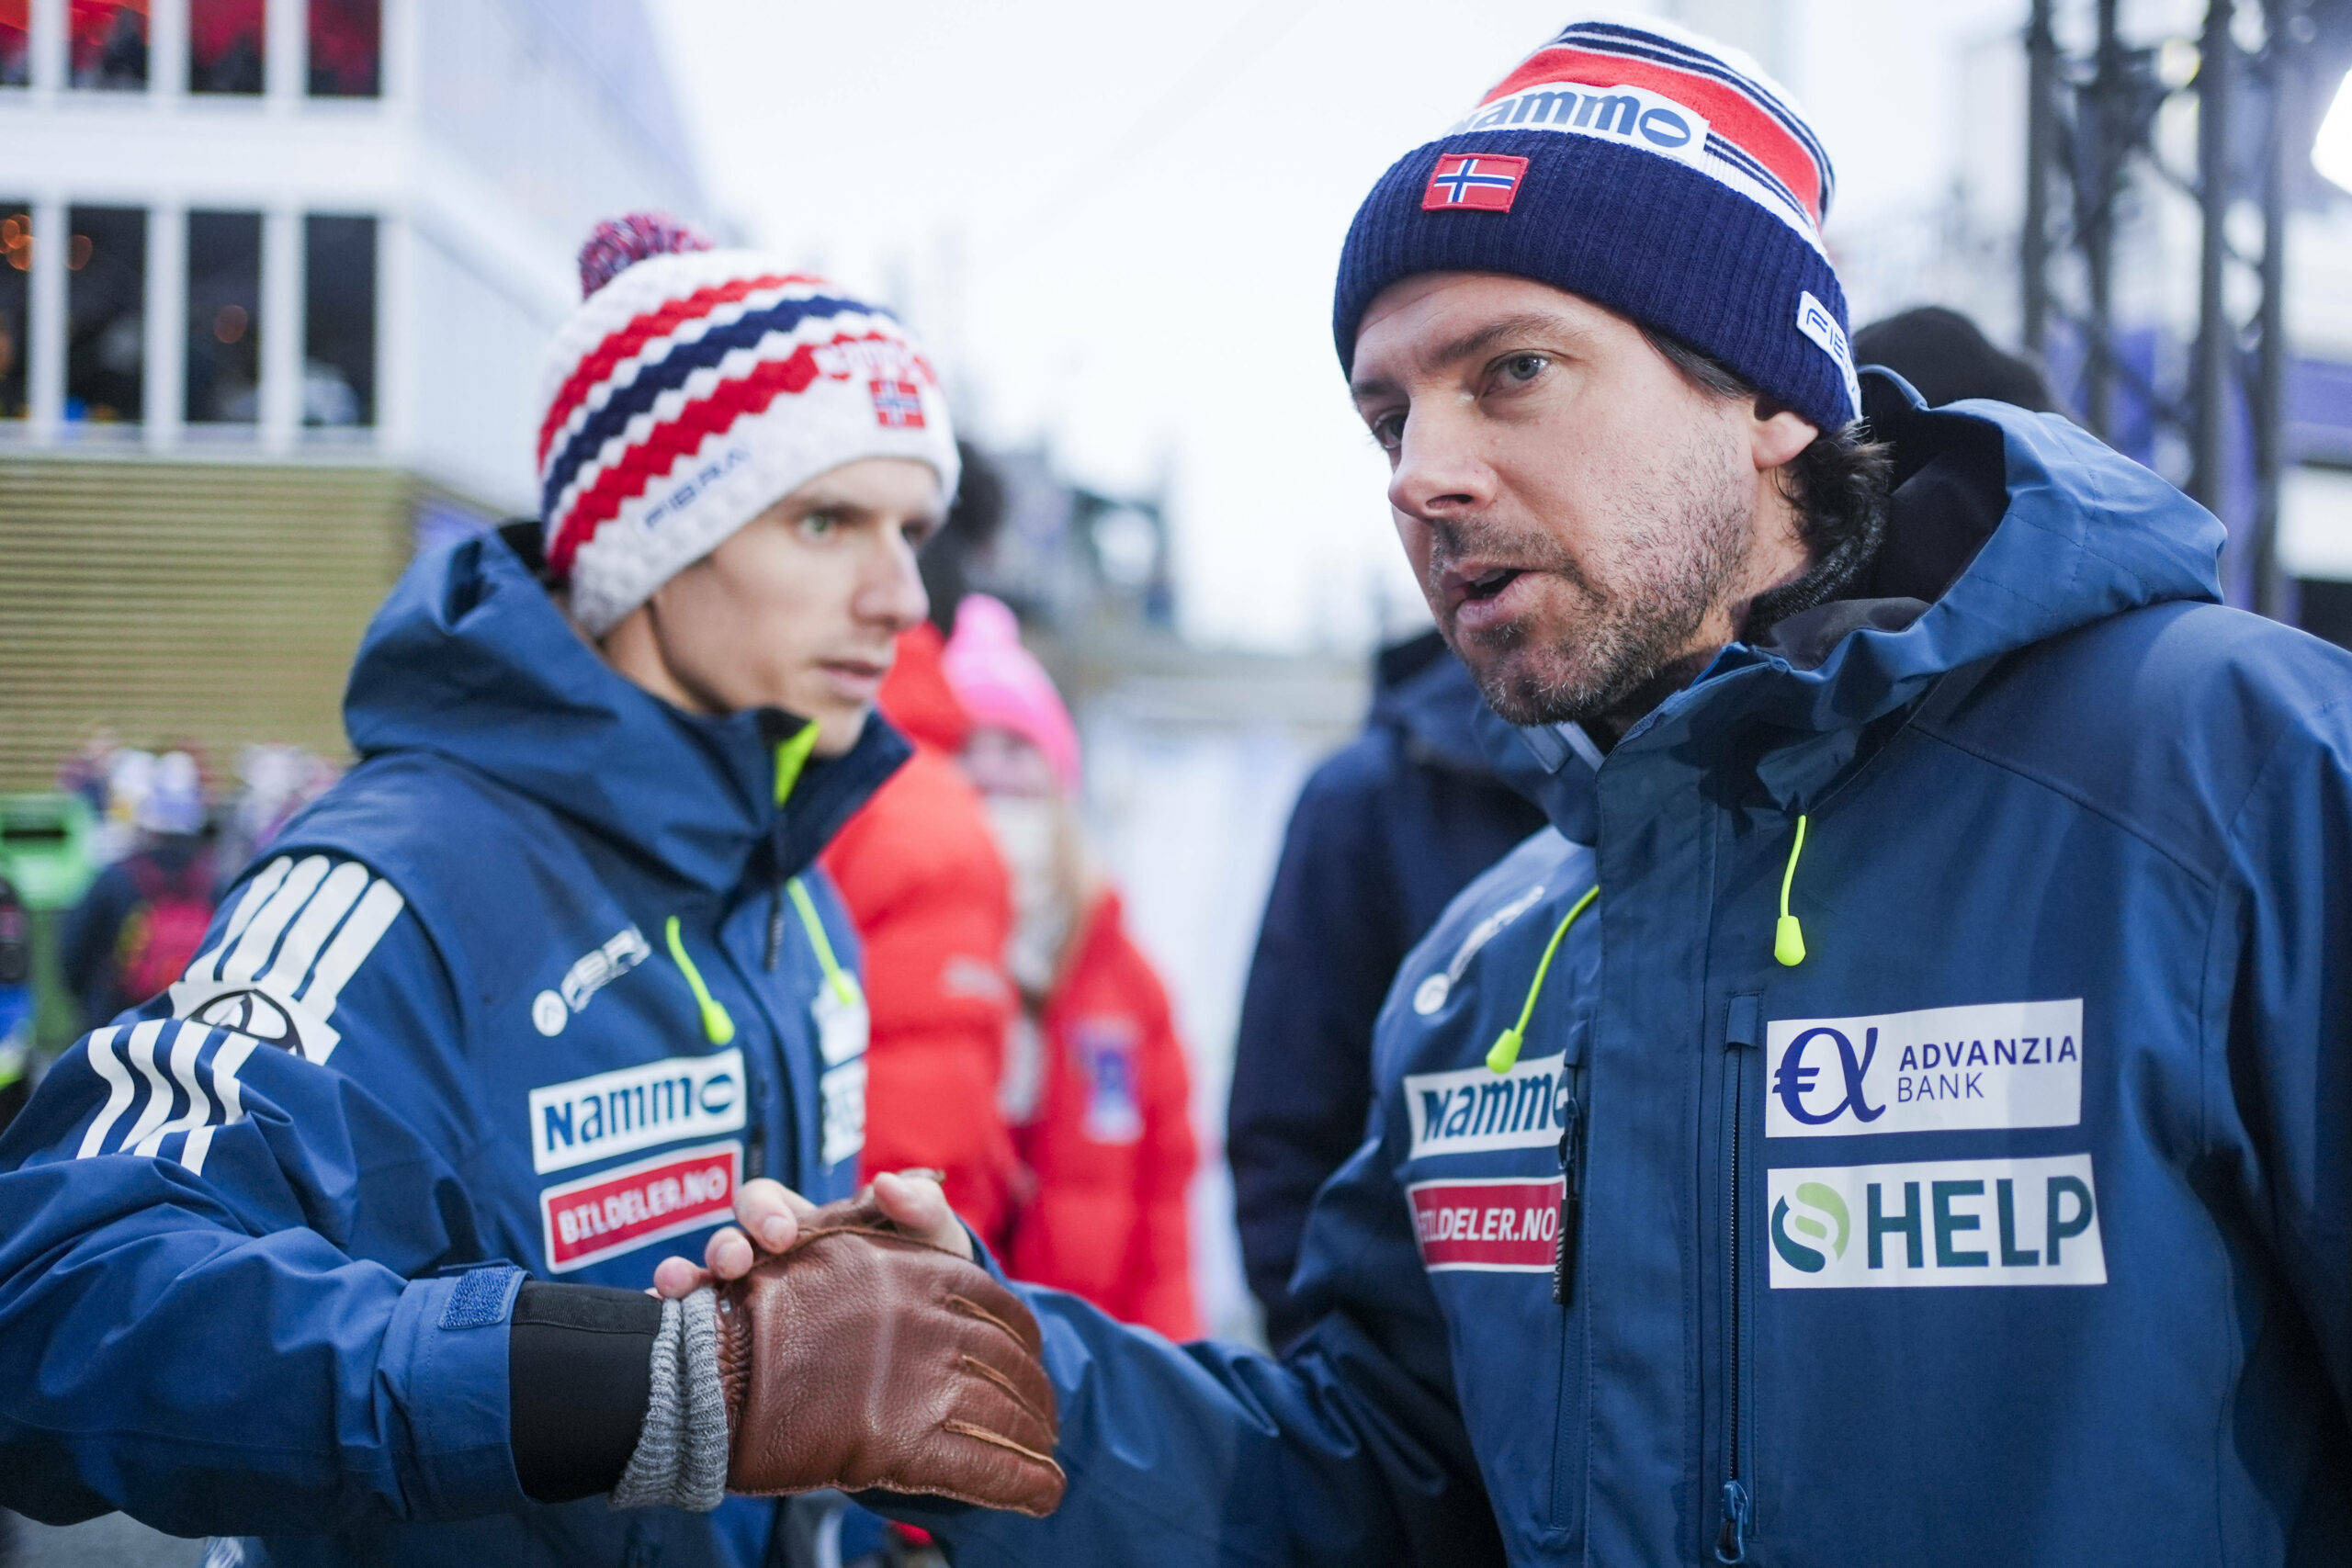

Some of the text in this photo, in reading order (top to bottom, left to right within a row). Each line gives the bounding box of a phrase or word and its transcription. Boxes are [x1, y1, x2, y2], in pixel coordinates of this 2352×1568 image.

[1805, 308, 1856, 393] FIB
[1897, 1072, 1984, 1102] BANK
[1899, 1035, 2077, 1071] ADVANZIA
[543, 1073, 734, 1151] Nammo
[558, 1166, 728, 1245] BILDELER.NO
[1866, 1175, 2093, 1269] HELP
